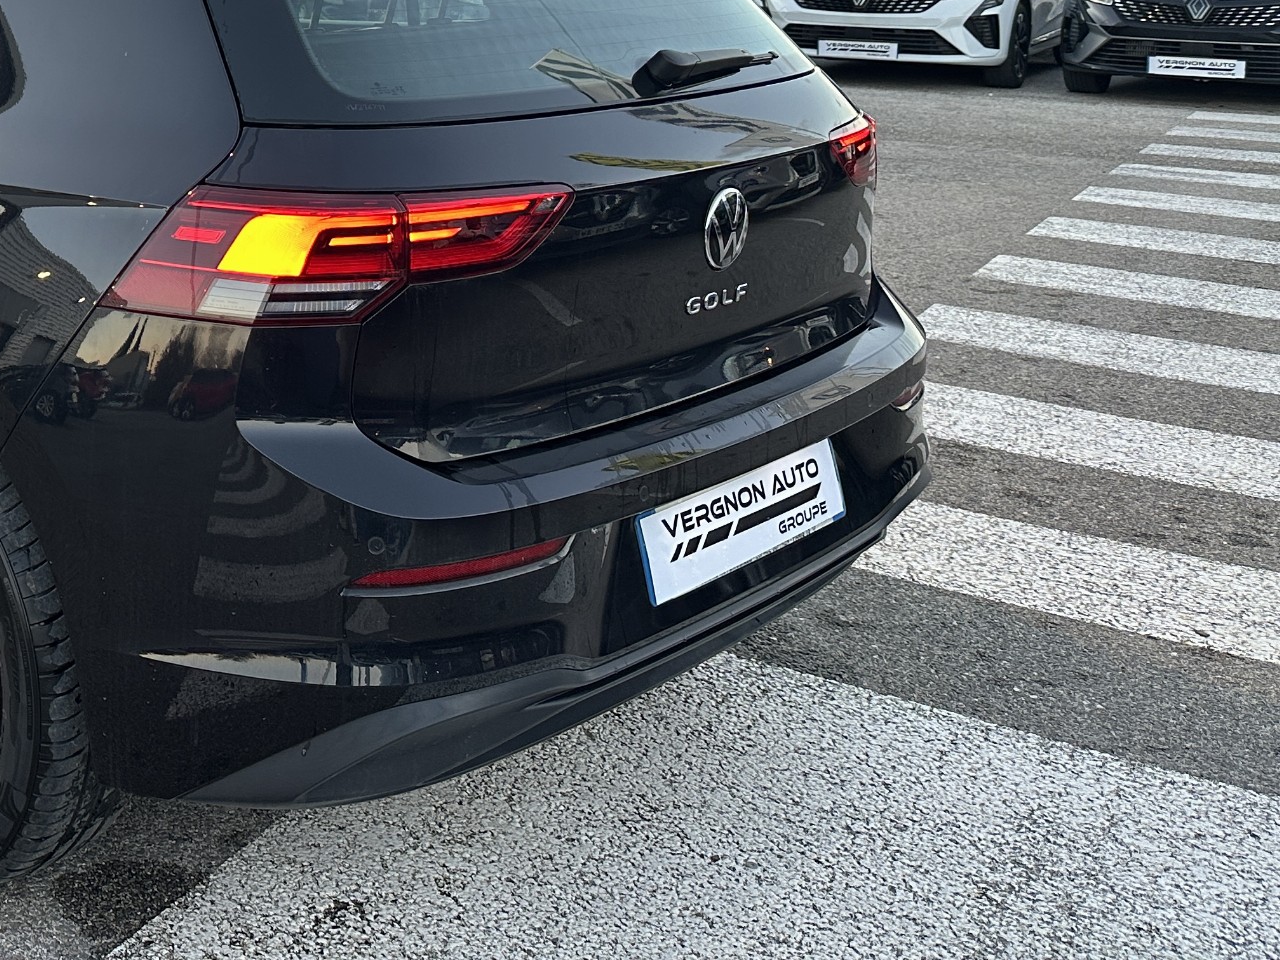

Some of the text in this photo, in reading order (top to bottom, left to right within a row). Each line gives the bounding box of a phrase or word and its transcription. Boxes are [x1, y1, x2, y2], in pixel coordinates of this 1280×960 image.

[685, 283, 748, 315] GOLF
[661, 458, 819, 538] VERGNON AUTO
[779, 501, 828, 534] GROUPE
